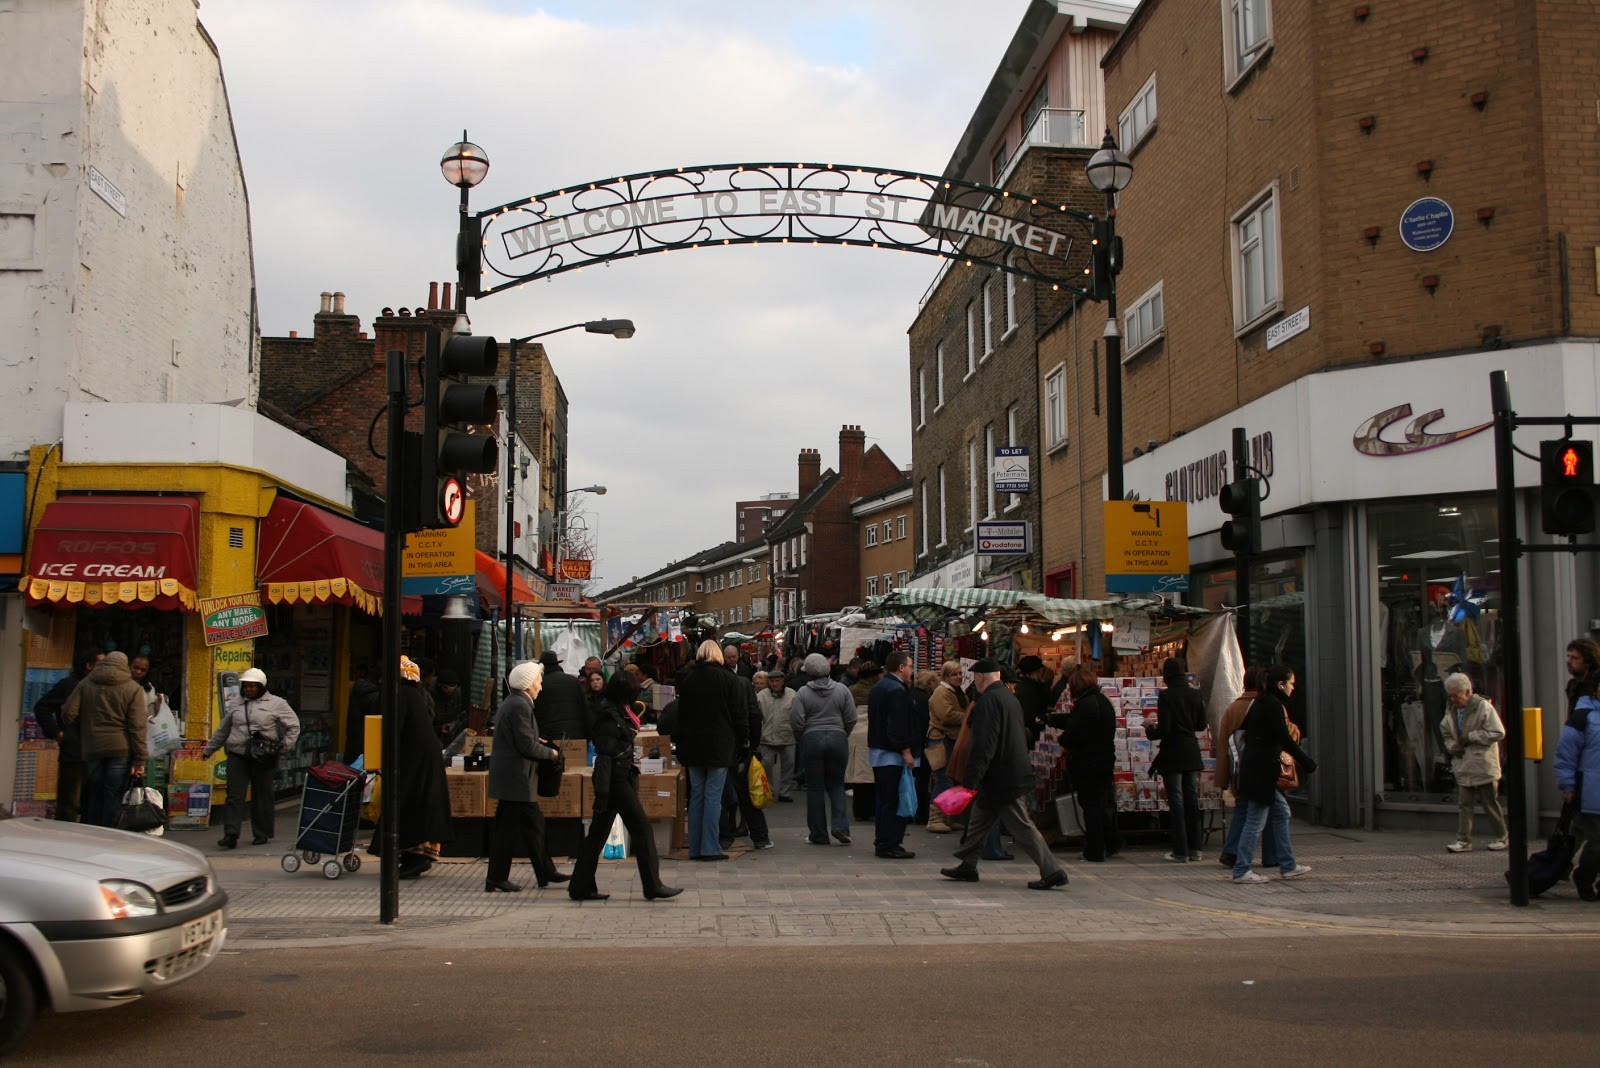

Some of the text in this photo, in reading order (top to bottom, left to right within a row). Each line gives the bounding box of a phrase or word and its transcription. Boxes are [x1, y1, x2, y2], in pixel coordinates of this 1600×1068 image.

[510, 196, 677, 254] WELCOME
[694, 191, 738, 217] TO
[760, 190, 843, 216] EAST
[932, 203, 1066, 256] MARKET
[1404, 211, 1448, 224] Charlie Chaplin
[1268, 325, 1280, 341] EAST
[1282, 312, 1302, 333] STREET
[38, 563, 166, 578] ICE CREAM
[202, 597, 227, 616] UNLOCK
[229, 595, 242, 607] YOUR
[218, 607, 253, 619] ANY MAKE
[212, 614, 259, 628] ANY MODEL
[215, 647, 251, 665] Repairs
